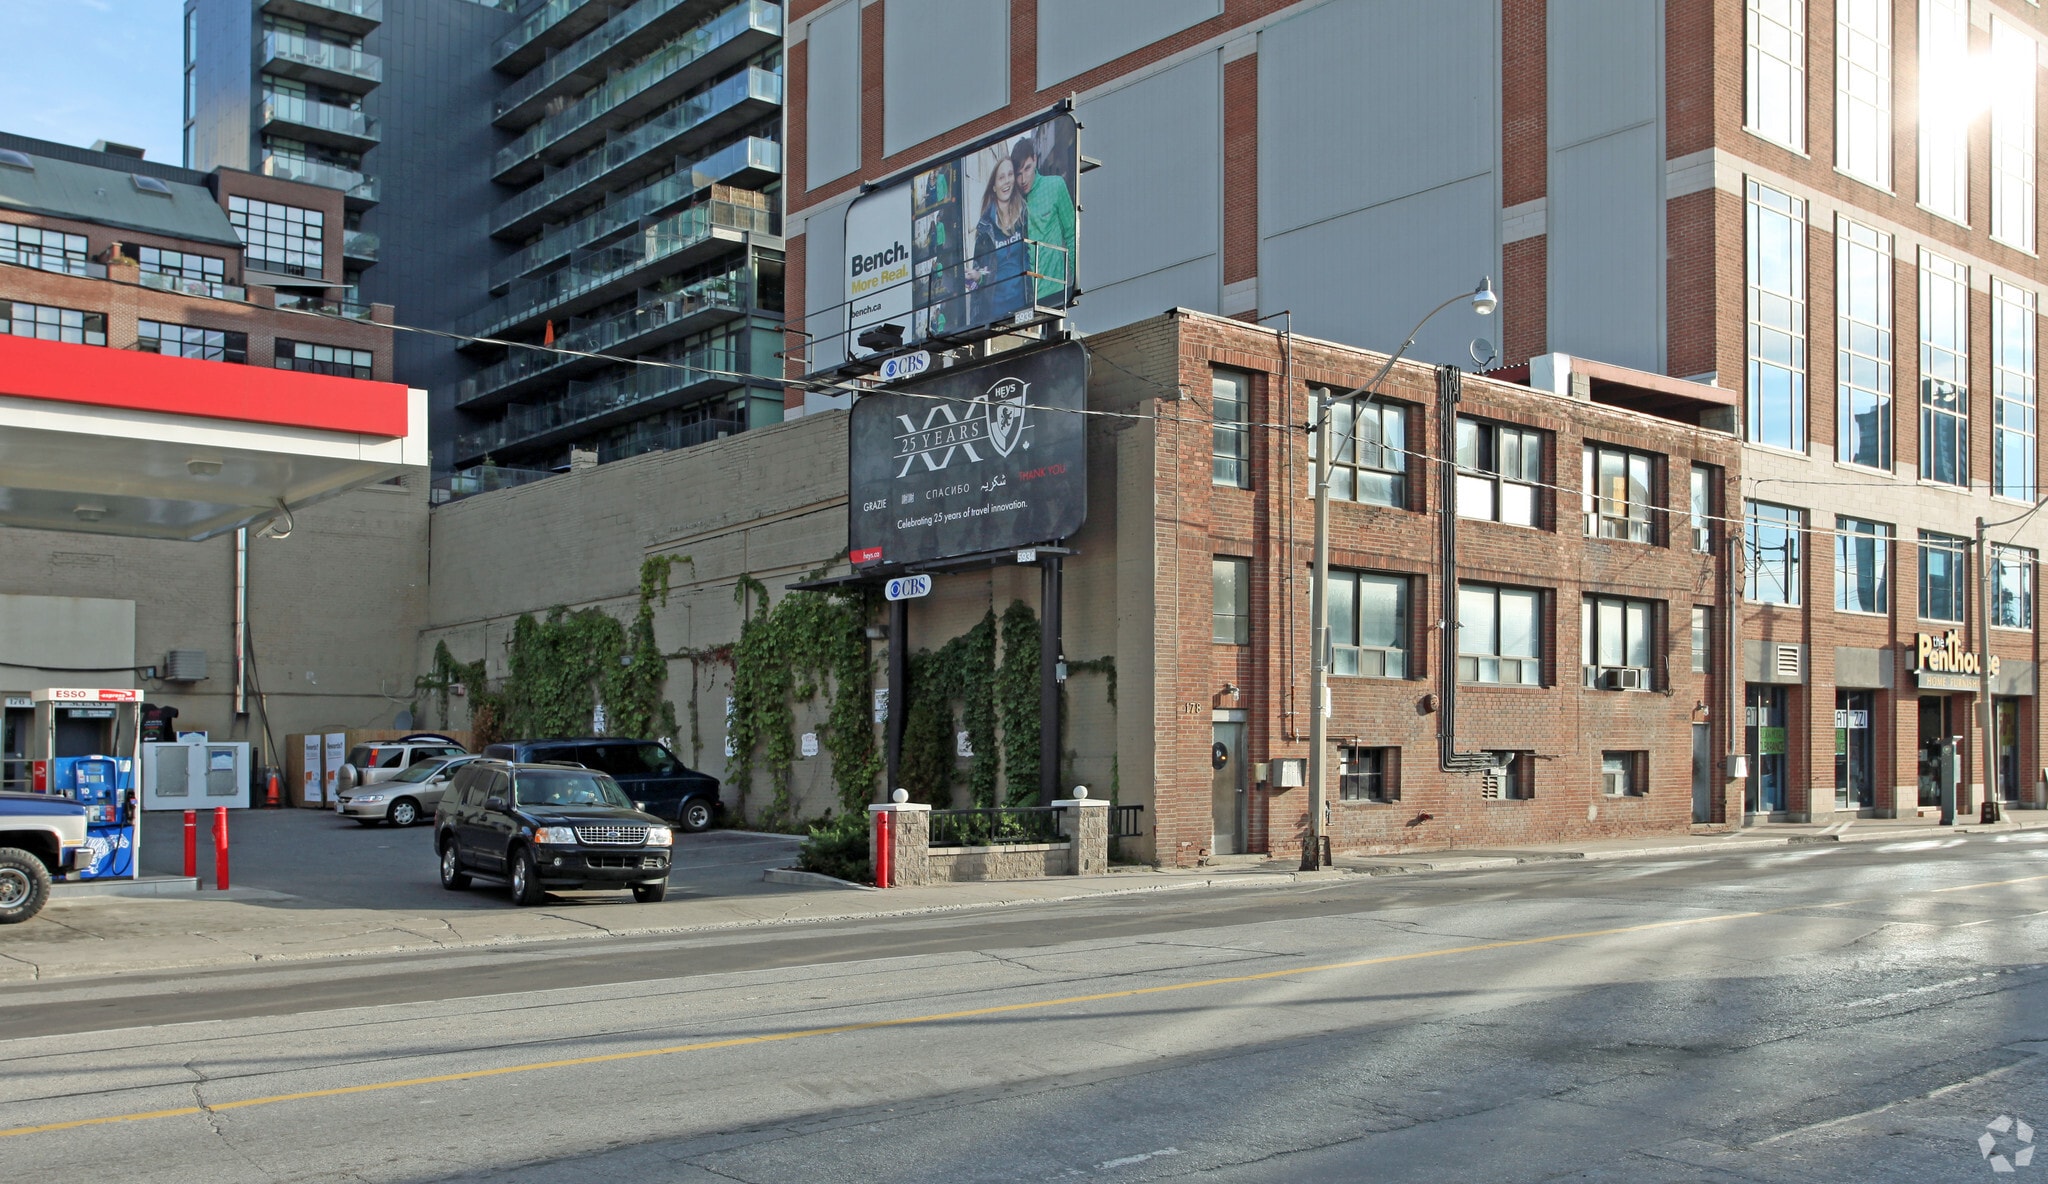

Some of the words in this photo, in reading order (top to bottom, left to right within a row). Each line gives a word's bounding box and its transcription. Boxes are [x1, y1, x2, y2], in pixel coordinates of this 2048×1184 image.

[852, 240, 909, 277] Bench.
[851, 277, 879, 295] More
[881, 264, 909, 285] Real.
[1015, 310, 1034, 324] 5933
[898, 353, 924, 375] CBS
[995, 383, 1016, 399] HEYS
[901, 437, 917, 453] 25
[922, 421, 979, 448] YEARS
[1019, 467, 1046, 481] THANK
[1047, 464, 1067, 476] YOU
[925, 483, 970, 500] СПАСИБО
[863, 498, 887, 512] GRAZIE
[897, 516, 933, 530] Celebrating
[933, 512, 943, 523] 25
[943, 513, 962, 524] years
[962, 506, 971, 518] of
[971, 503, 990, 517] travel
[990, 499, 1028, 513] innovation.
[902, 577, 926, 596] CBS
[1932, 635, 1945, 648] the
[1919, 629, 2000, 676] Penthoue
[1926, 676, 1946, 687] HOME
[56, 690, 87, 698] ESSO
[1185, 702, 1201, 714] 178
